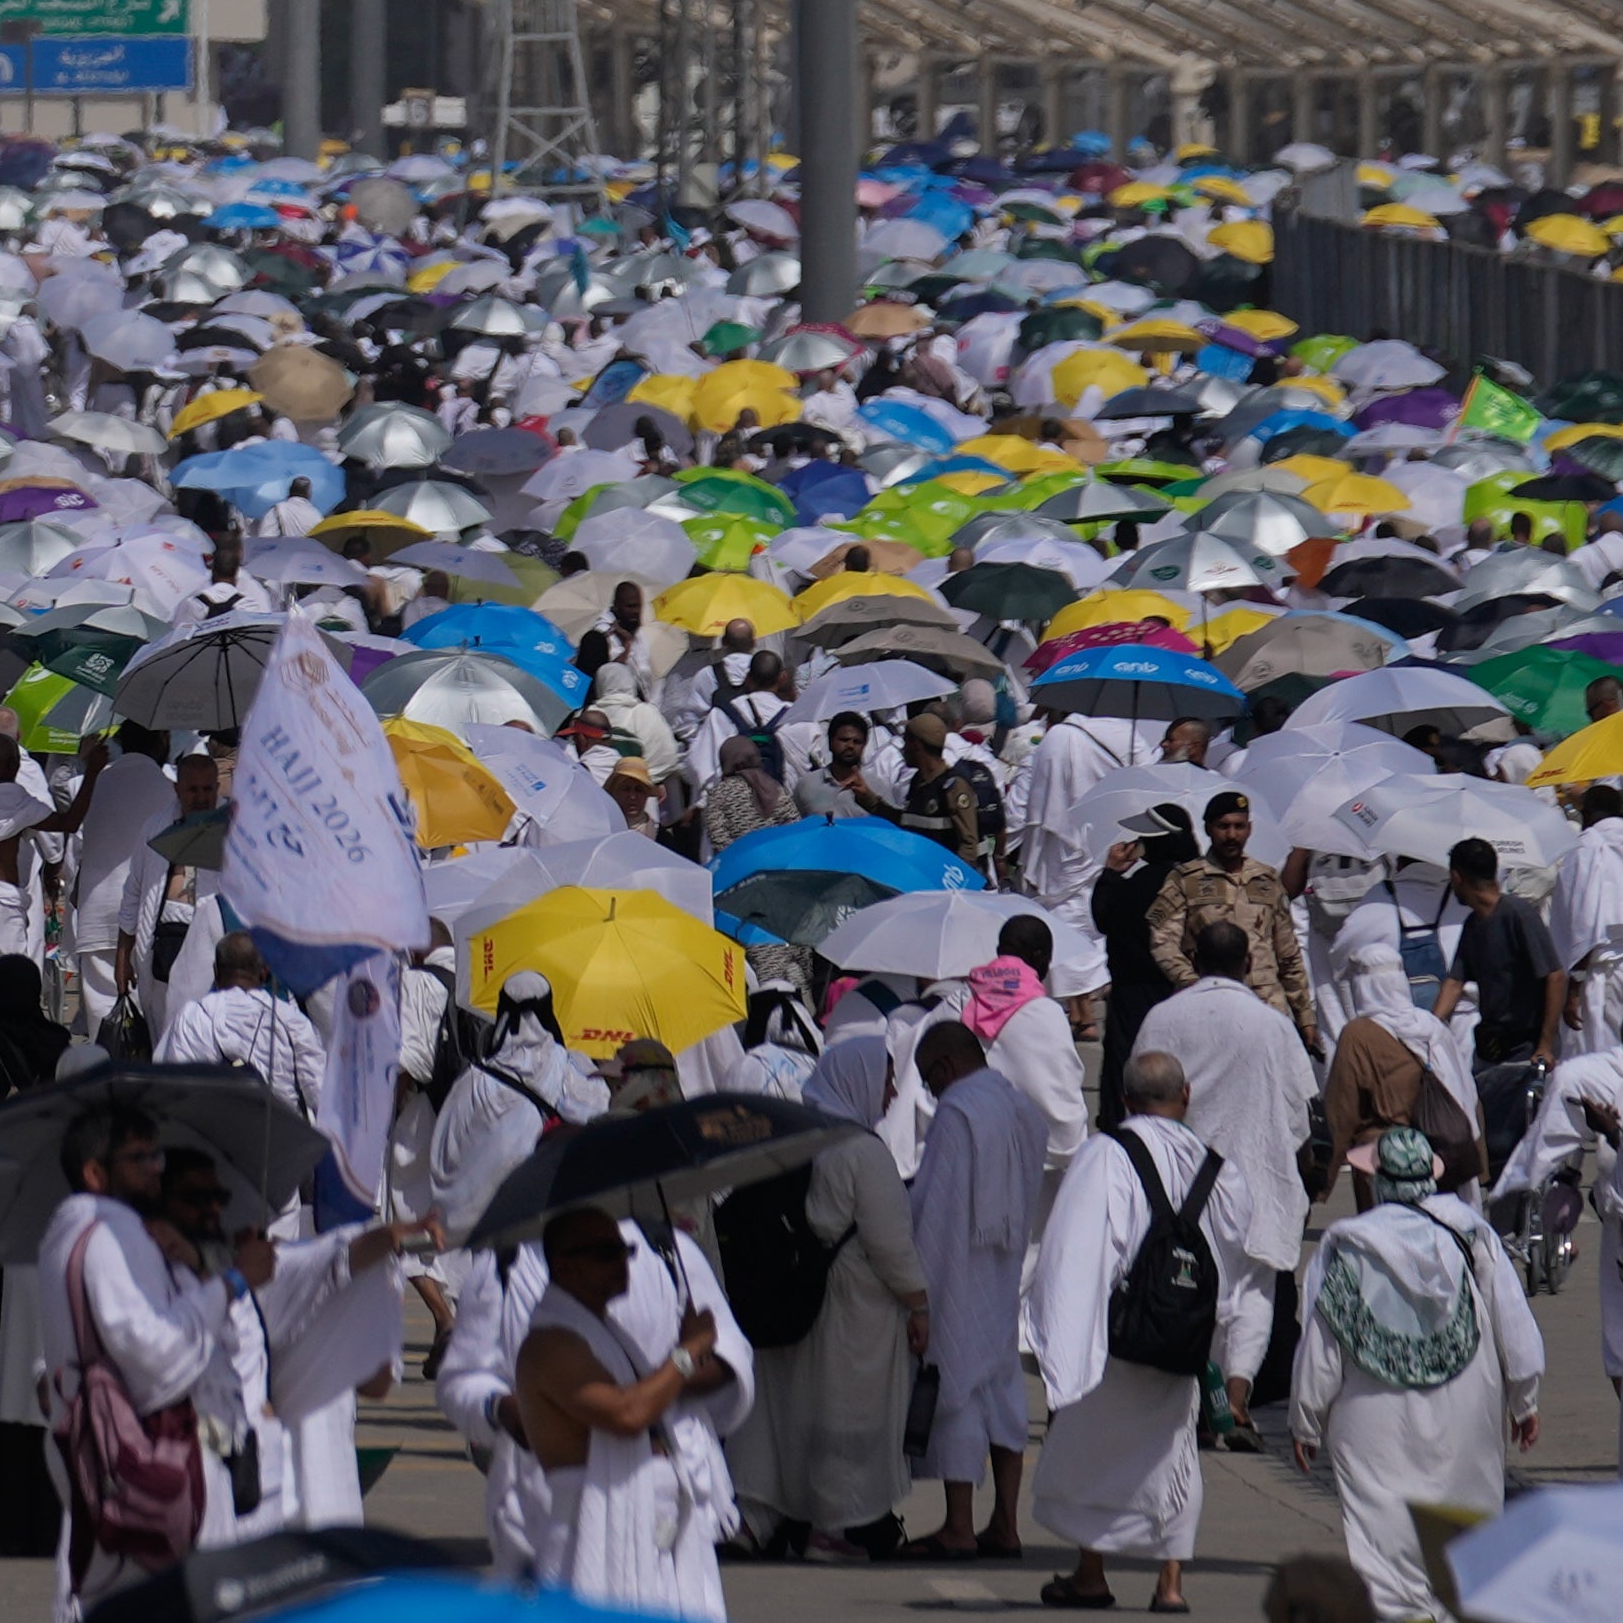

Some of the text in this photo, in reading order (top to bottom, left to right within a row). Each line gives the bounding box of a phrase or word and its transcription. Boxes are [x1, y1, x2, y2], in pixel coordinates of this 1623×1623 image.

[1113, 661, 1159, 675] anb
[260, 725, 374, 863] HAJJ 2026
[484, 939, 493, 982] DHL
[572, 1029, 635, 1043] DHL
